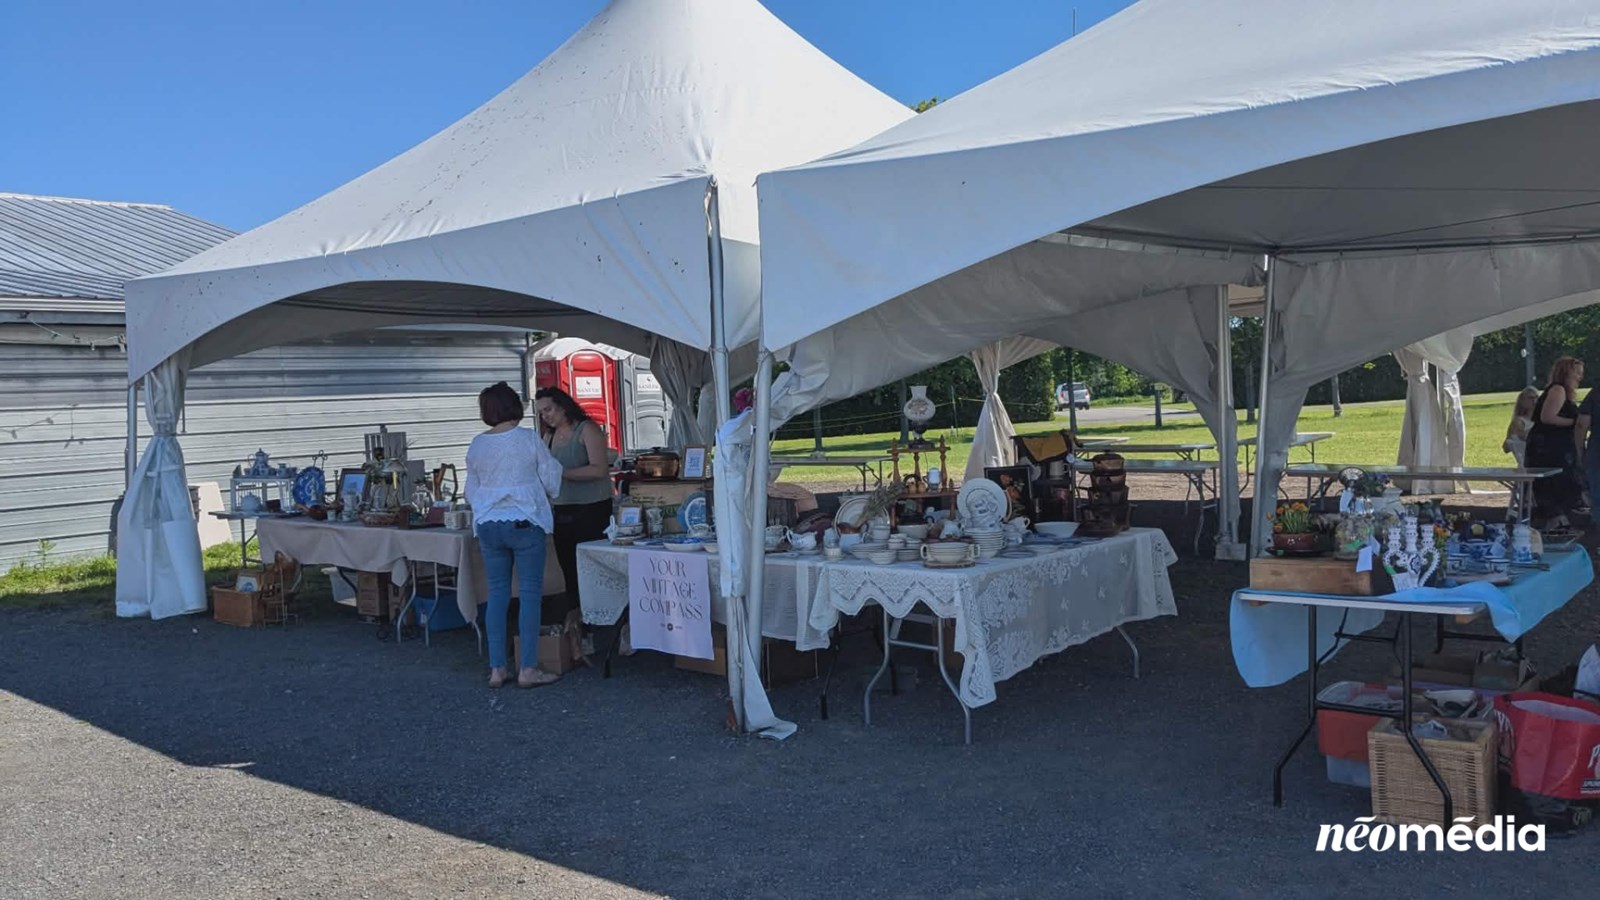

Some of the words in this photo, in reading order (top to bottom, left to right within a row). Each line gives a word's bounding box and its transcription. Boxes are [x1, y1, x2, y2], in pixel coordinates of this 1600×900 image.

[649, 557, 686, 577] YOUR
[642, 576, 697, 600] VINTAGE
[639, 597, 703, 619] COMPASS
